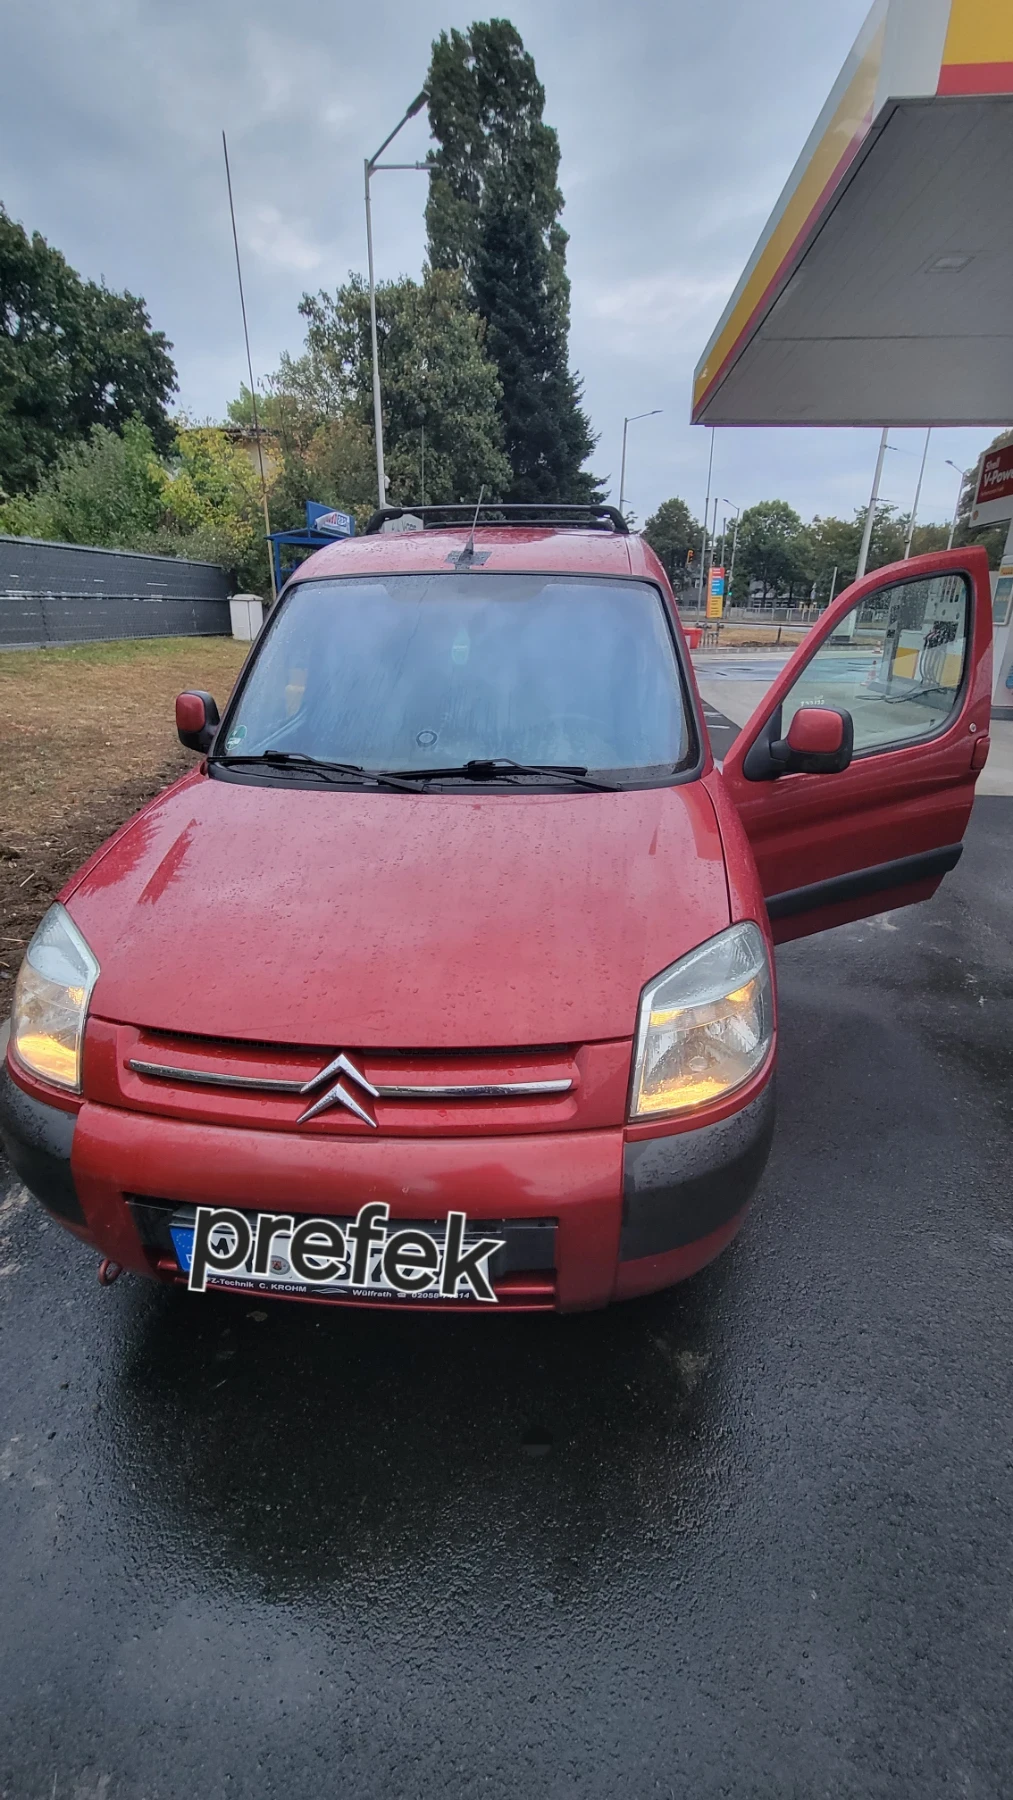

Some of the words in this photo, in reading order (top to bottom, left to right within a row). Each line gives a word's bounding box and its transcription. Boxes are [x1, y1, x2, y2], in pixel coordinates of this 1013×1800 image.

[985, 456, 1000, 472] Shell
[206, 1277, 254, 1288] FZ-Technik
[258, 1282, 269, 1290] C.
[270, 1283, 307, 1292] KROHM
[352, 1289, 392, 1298] Wülfrath
